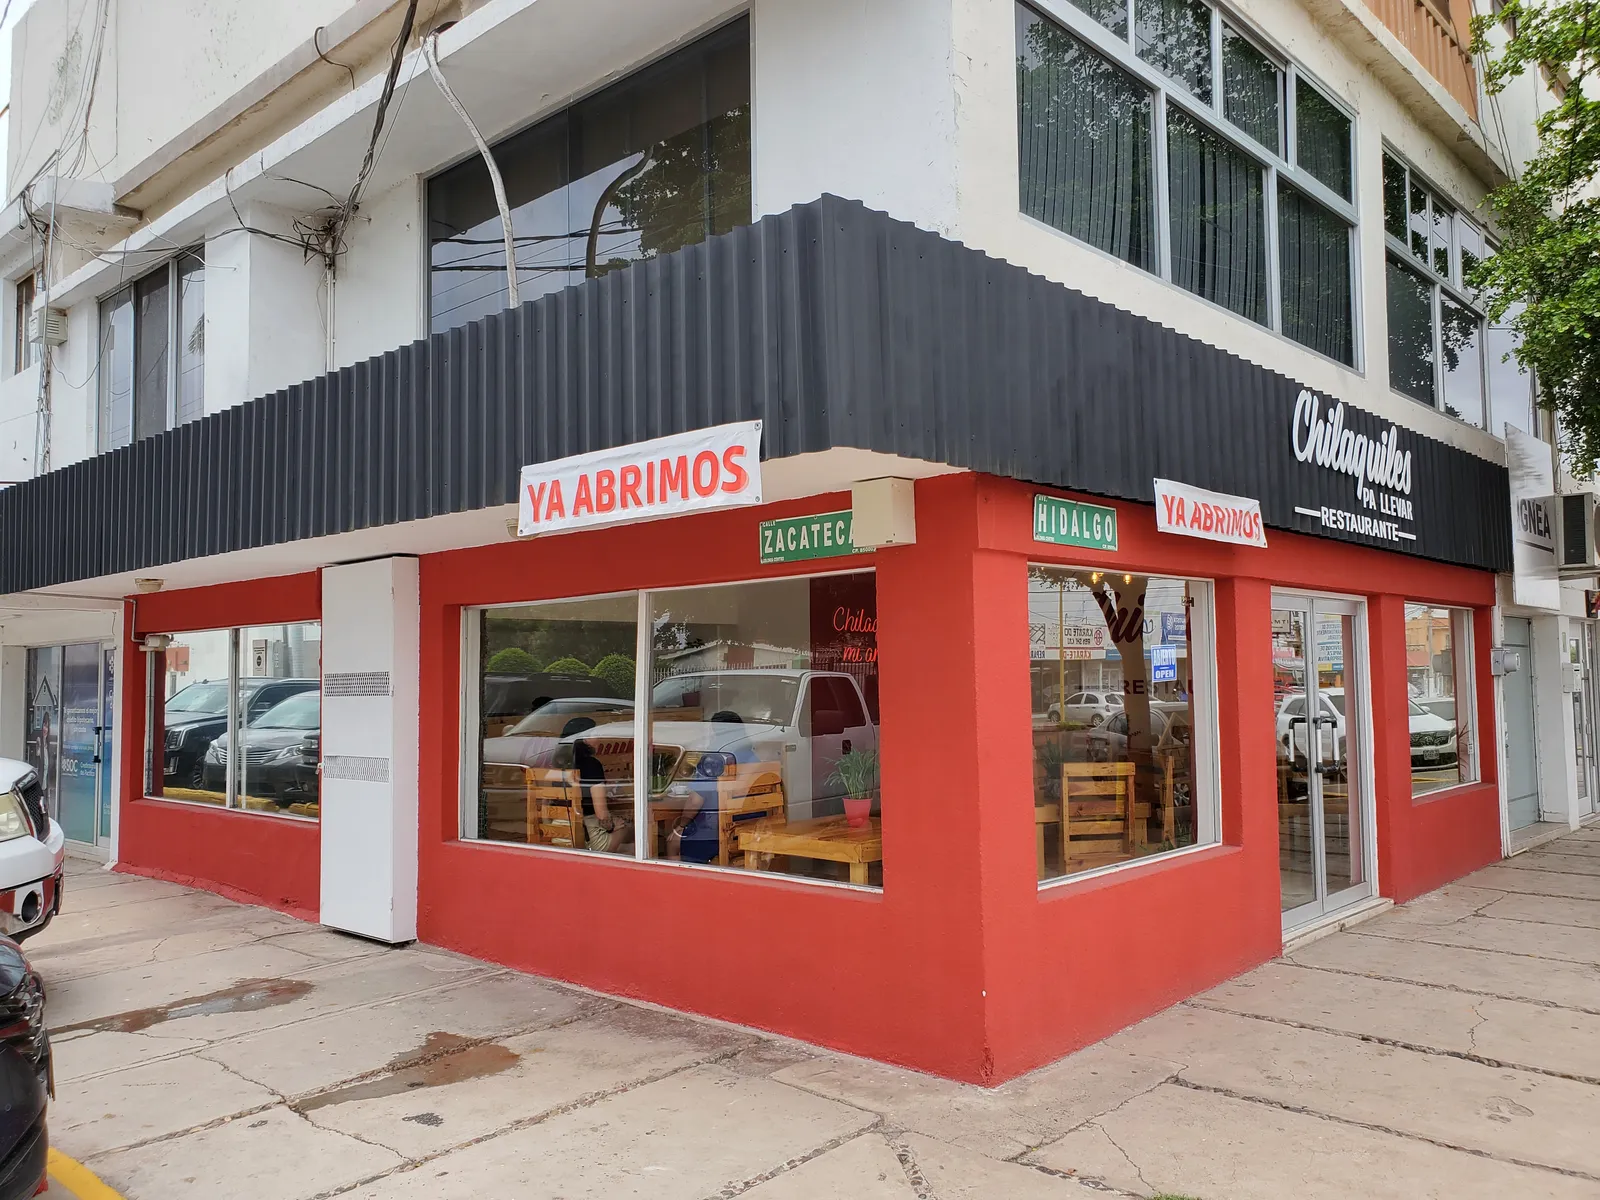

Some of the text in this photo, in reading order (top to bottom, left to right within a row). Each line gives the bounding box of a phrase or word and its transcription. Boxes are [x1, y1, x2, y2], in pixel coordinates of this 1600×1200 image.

[1292, 389, 1412, 500] Chilaquiles
[526, 445, 750, 524] YA ABRIMOS
[1037, 503, 1113, 542] HIDALGO
[1161, 494, 1261, 542] YA ABRIMOS
[1363, 487, 1414, 521] PA LLEVAR
[764, 519, 854, 554] ZACATEC
[1320, 505, 1400, 542] RESTAURANTE
[1153, 649, 1176, 666] ABIERTO
[1155, 669, 1174, 679] OPEN
